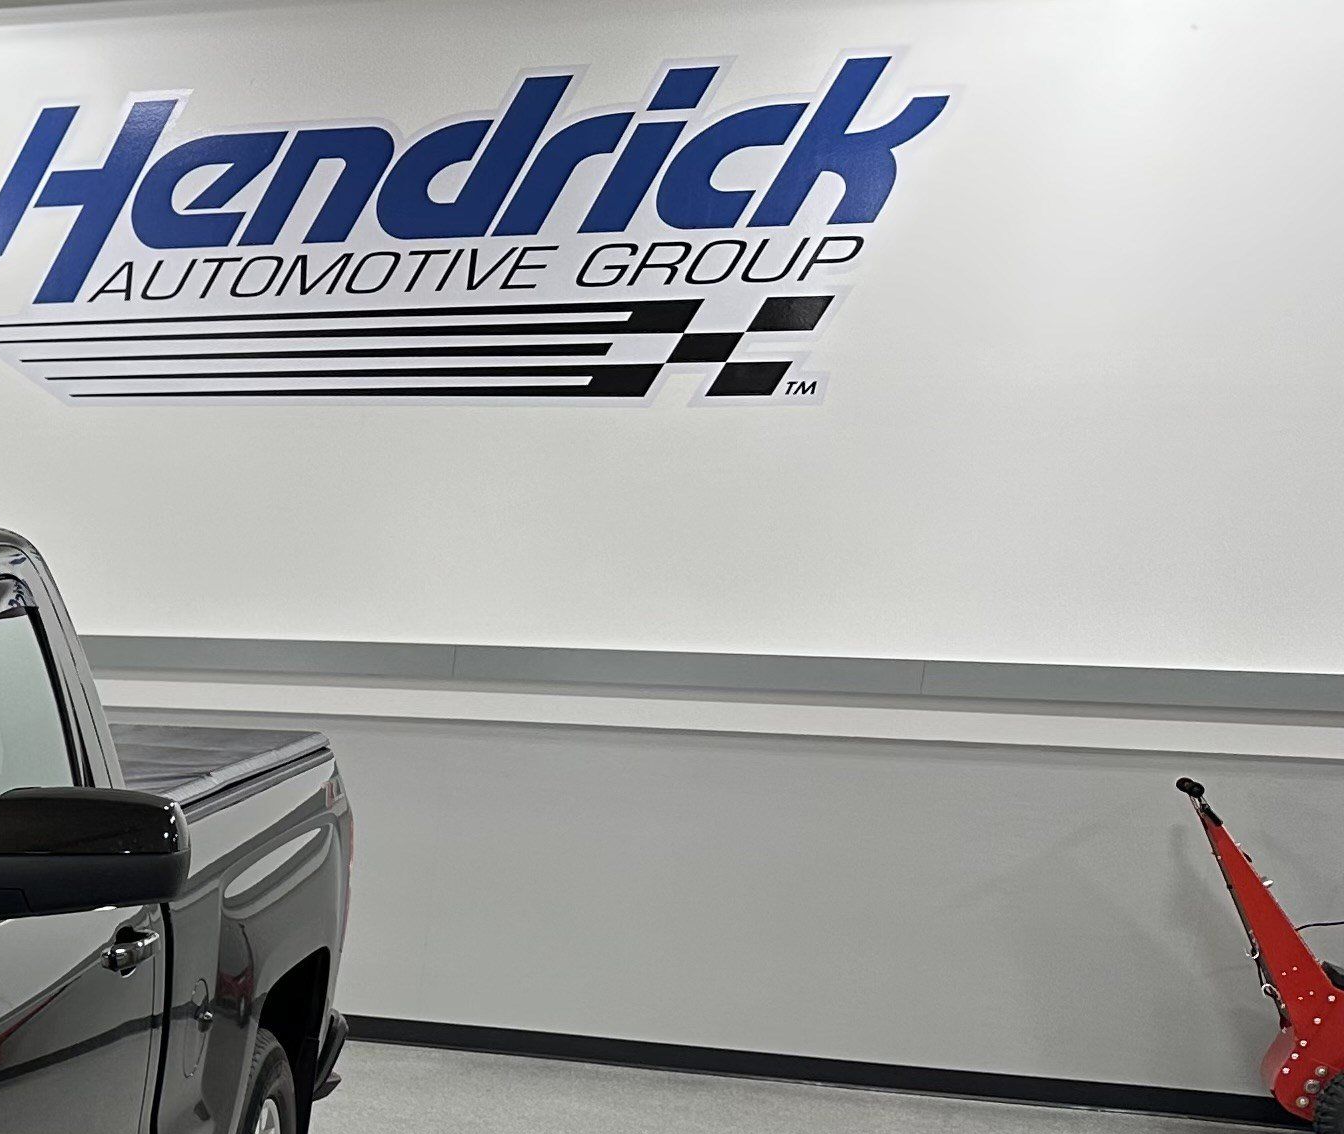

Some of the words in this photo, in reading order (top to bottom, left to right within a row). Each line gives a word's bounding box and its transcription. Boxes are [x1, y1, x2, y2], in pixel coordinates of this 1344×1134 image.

[87, 246, 560, 303] AUTOMOTIVE
[576, 236, 865, 288] GROUP
[785, 381, 818, 395] TM
